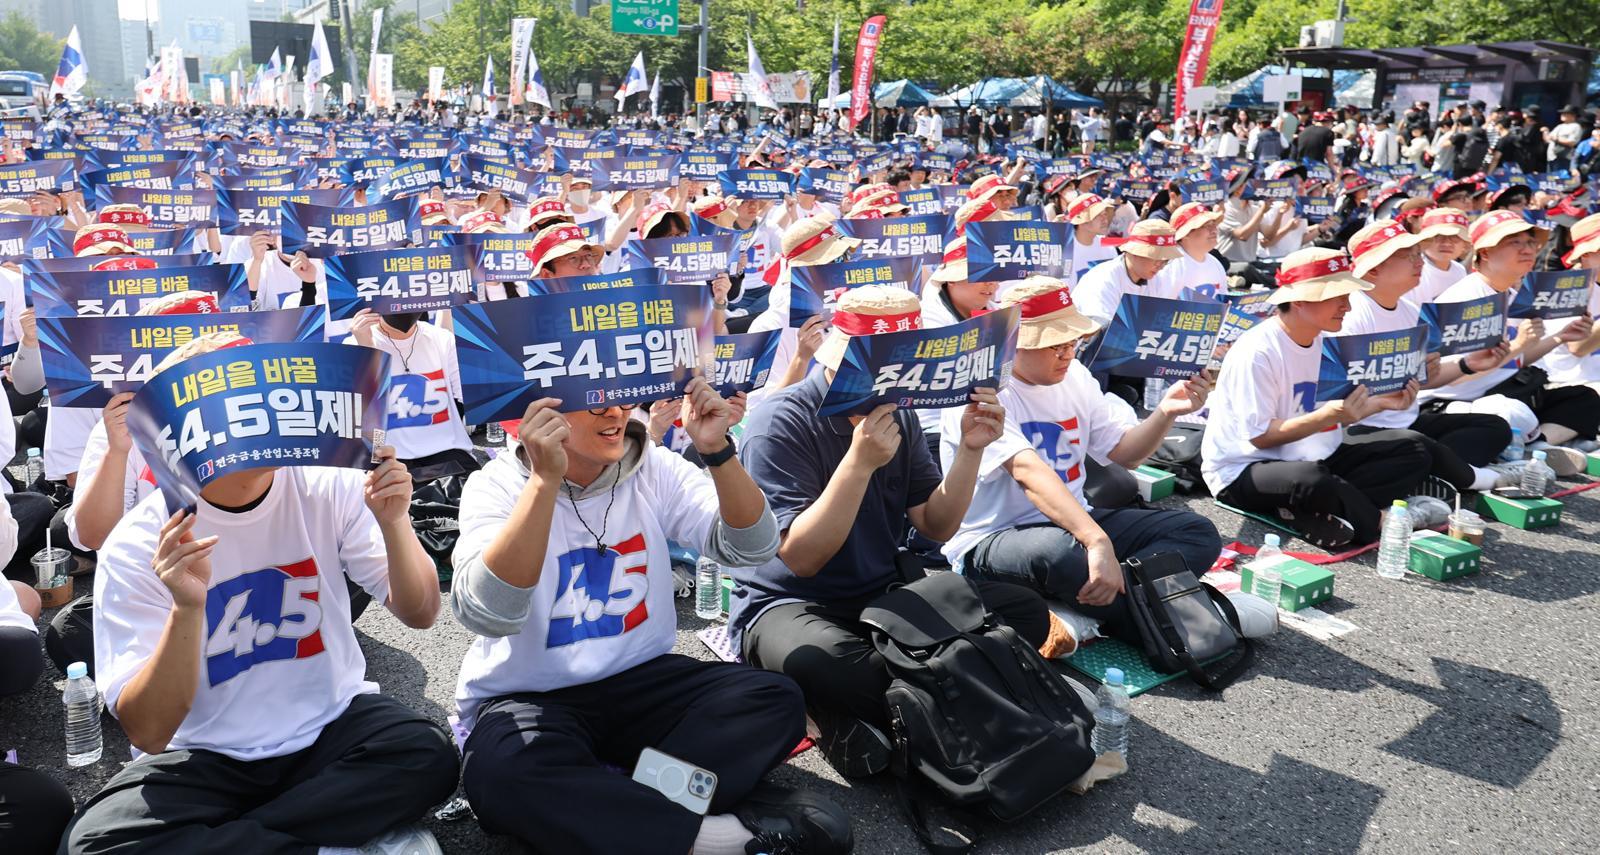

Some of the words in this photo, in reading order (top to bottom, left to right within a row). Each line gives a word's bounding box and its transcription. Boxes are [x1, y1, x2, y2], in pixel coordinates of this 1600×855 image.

[1190, 15, 1218, 27] BNK
[123, 154, 147, 162] 내일을
[148, 154, 164, 162] 바꿀
[238, 154, 288, 167] 주4.5일제!
[400, 148, 448, 158] 주4.5일제!
[18, 169, 36, 178] 바꿀
[484, 164, 504, 175] 내일을
[504, 169, 518, 180] 바꿀
[624, 161, 644, 170] 내일을
[646, 160, 658, 168] 바꿀
[680, 162, 728, 176] 주4.5일제!
[0, 176, 56, 192] .5일제!
[107, 172, 132, 182] 내일을
[133, 169, 152, 178] 바꿀
[380, 170, 442, 196] 주4.5일제!
[472, 170, 527, 196] 주4.5일제!
[610, 168, 668, 184] 주4.5일제!
[736, 180, 790, 194] 주4.5일제!
[143, 194, 172, 205] 내일을
[174, 194, 192, 205] 바꿀
[143, 205, 210, 222] 4.5일제!
[332, 213, 366, 226] 내일을
[368, 209, 388, 224] 바꿀
[307, 220, 406, 248] 주4.5일제!
[883, 225, 910, 236] 내일을
[910, 222, 926, 234] 바꿀
[1014, 228, 1037, 242] 내일을
[1038, 228, 1050, 242] 바꿀
[484, 240, 514, 251] 내일을
[672, 243, 696, 254] 내일을
[698, 241, 712, 252] 바꿀
[862, 234, 942, 258] 주4.5일제!
[384, 257, 424, 272] 내일을
[428, 254, 452, 271] 바꿀
[994, 244, 1062, 268] 주4.5일제!
[846, 268, 876, 284] 내일을
[876, 266, 893, 281] 바꿀
[109, 279, 157, 295] 내일을
[162, 276, 189, 292] 바꿀
[356, 269, 472, 302] 주4.5일제!
[570, 301, 639, 332] 내일을
[644, 299, 676, 325] 바꿀
[1171, 312, 1205, 332] 내일을
[1207, 314, 1222, 332] 바꿀
[130, 326, 194, 349] 내일을
[914, 335, 959, 359] 내일을
[960, 328, 980, 352] 바꿀
[1368, 340, 1395, 356] 내일을
[1396, 336, 1411, 351] 바꿀
[522, 327, 700, 388] 주4.5일제!
[872, 345, 996, 396] 주4.5일제!
[172, 360, 257, 408] 내일을
[262, 356, 318, 384] 바꿀
[389, 377, 449, 419] 4.5
[216, 448, 320, 468] 전국금융산업노동조합
[550, 551, 649, 628] 4.5
[207, 574, 323, 658] 4.5
